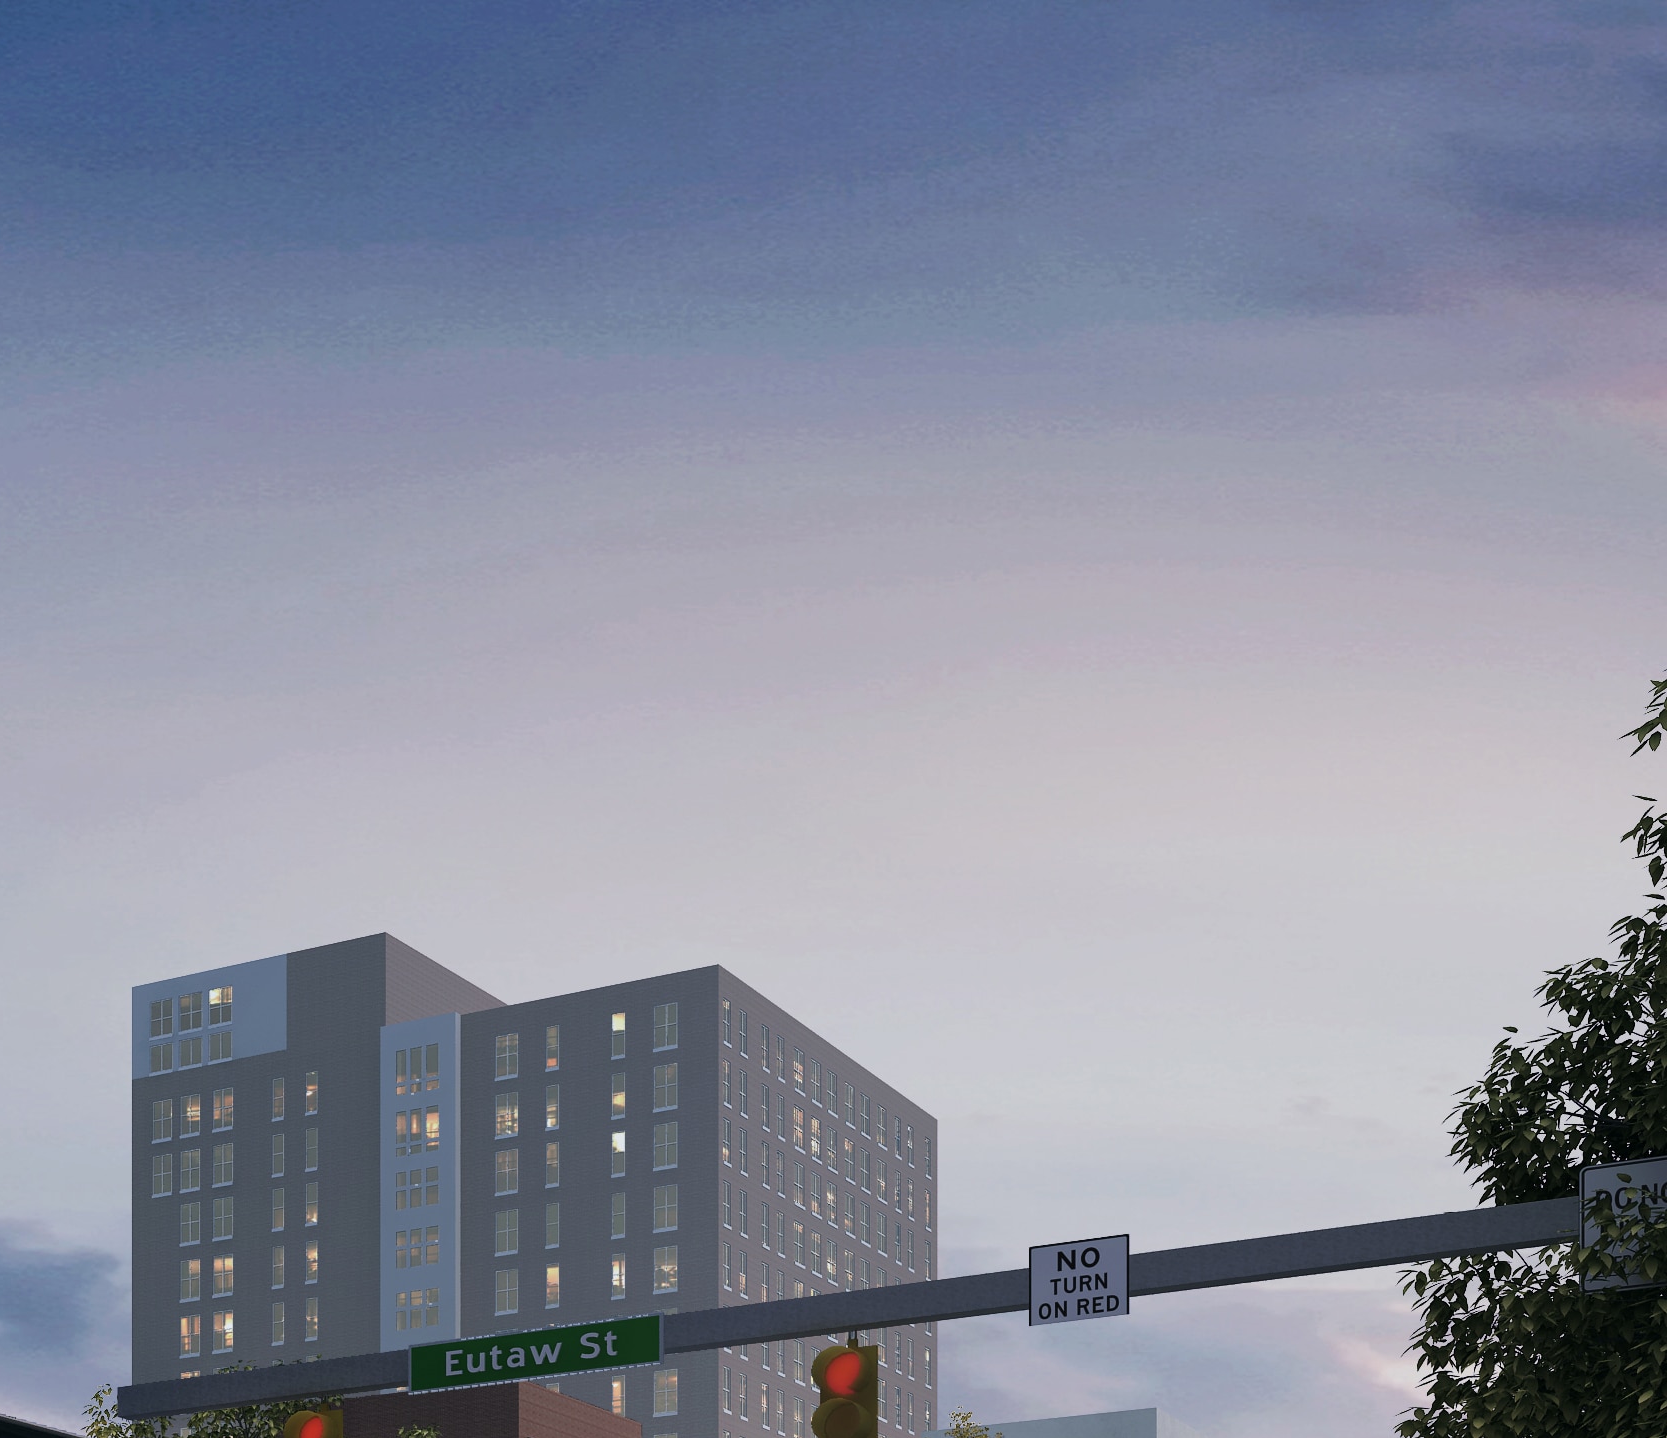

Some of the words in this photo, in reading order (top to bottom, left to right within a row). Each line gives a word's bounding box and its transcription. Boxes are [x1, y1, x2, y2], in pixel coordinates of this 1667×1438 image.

[1057, 1247, 1100, 1272] NO
[1050, 1272, 1107, 1295] TURN
[1038, 1301, 1067, 1320] ON
[1077, 1295, 1120, 1315] RED
[445, 1342, 562, 1376] Eutaw
[580, 1330, 618, 1359] St
